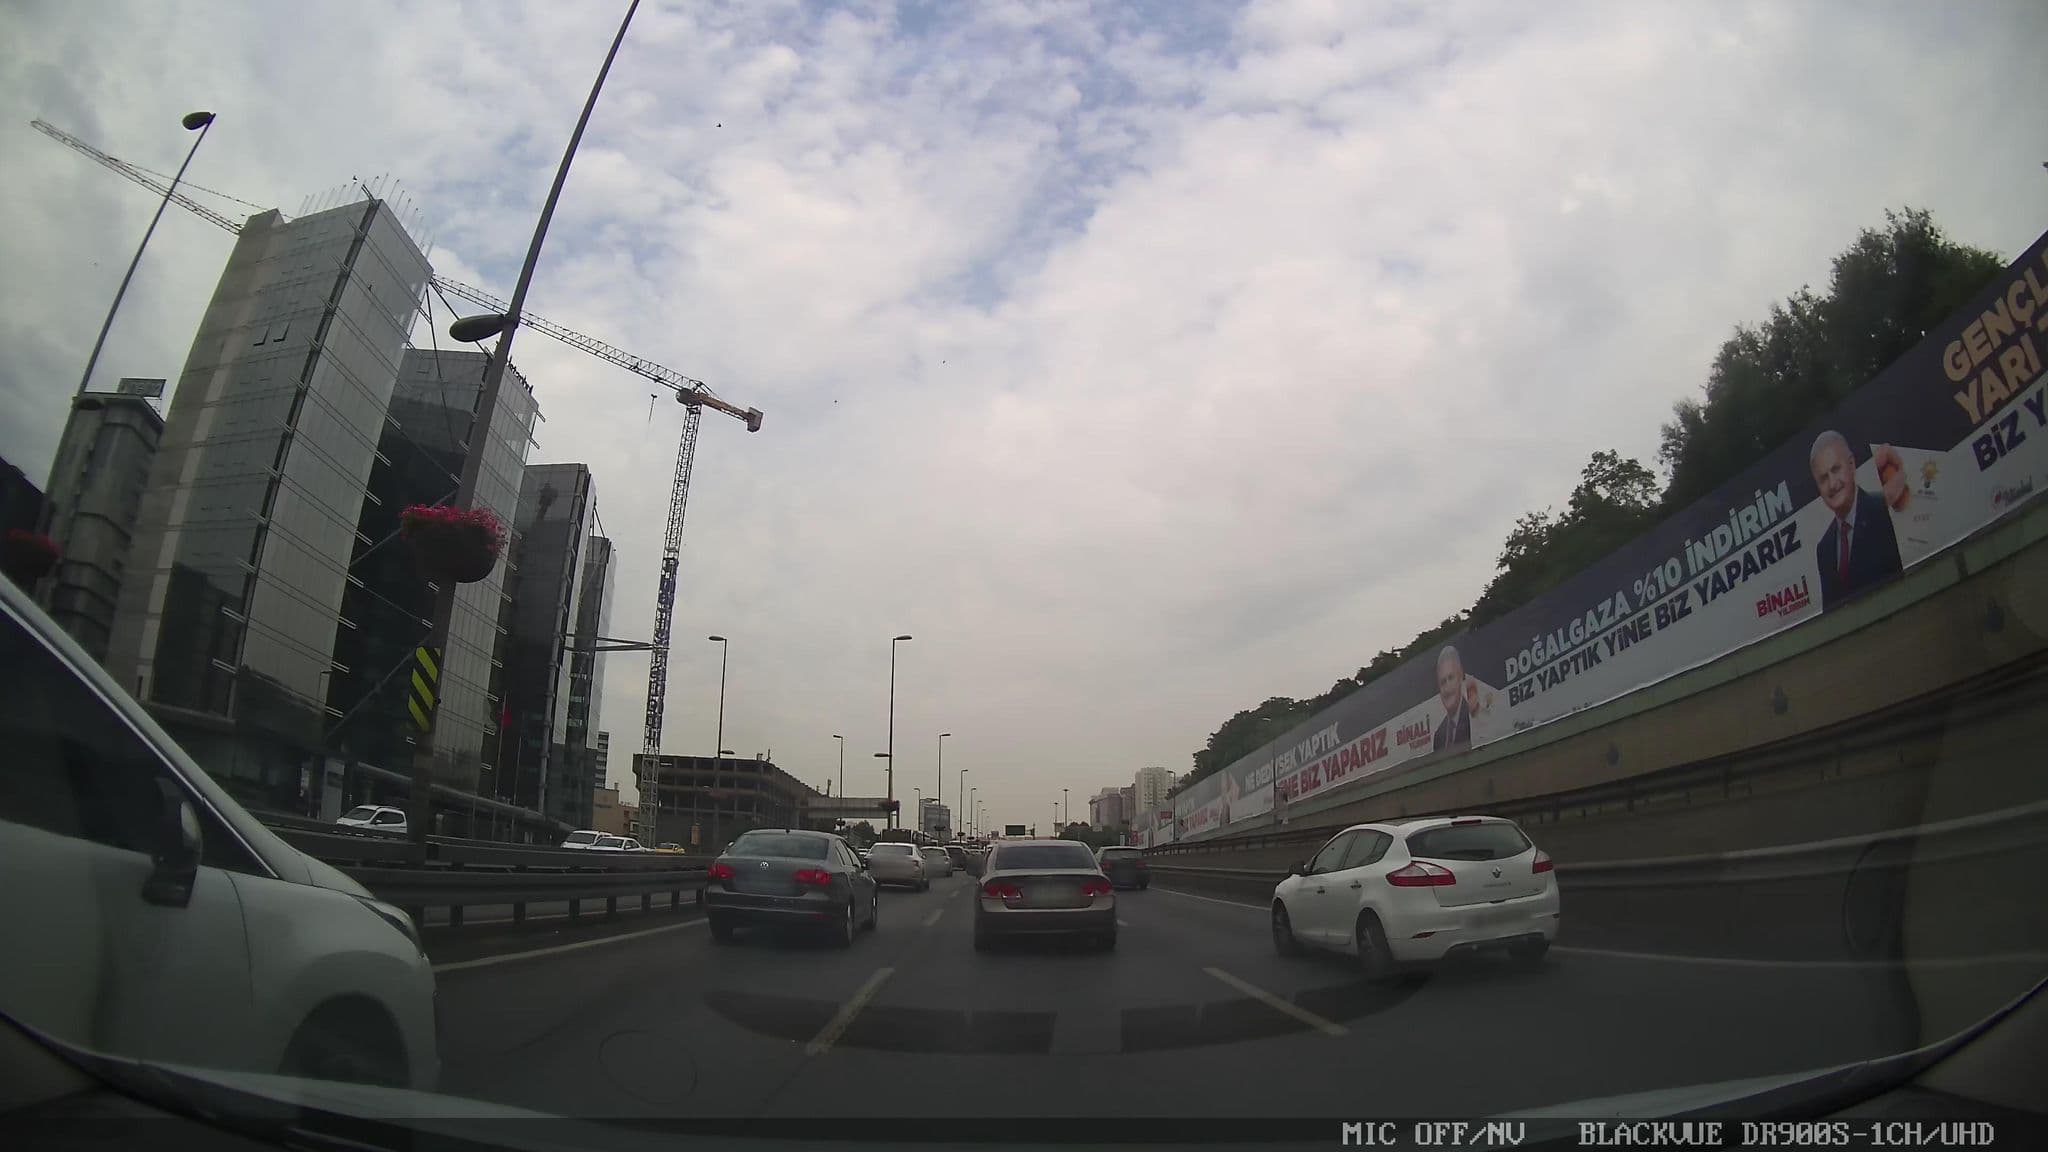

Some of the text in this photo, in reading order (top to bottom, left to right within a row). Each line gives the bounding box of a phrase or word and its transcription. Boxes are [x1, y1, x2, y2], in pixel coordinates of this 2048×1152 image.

[1943, 248, 2048, 382] GENÇL
[1953, 333, 2042, 425] YARI
[1972, 409, 2027, 472] BİZ
[1504, 480, 1793, 682] DOĞALGAZA %10 İNDİRİM
[1508, 520, 1801, 708] BİZ YAPTIK YİNE BİZ YAPARIZ
[1756, 575, 1809, 617] BİNALİ
[1298, 722, 1341, 762] YAPTIK
[1319, 727, 1388, 783] YAPARIZ
